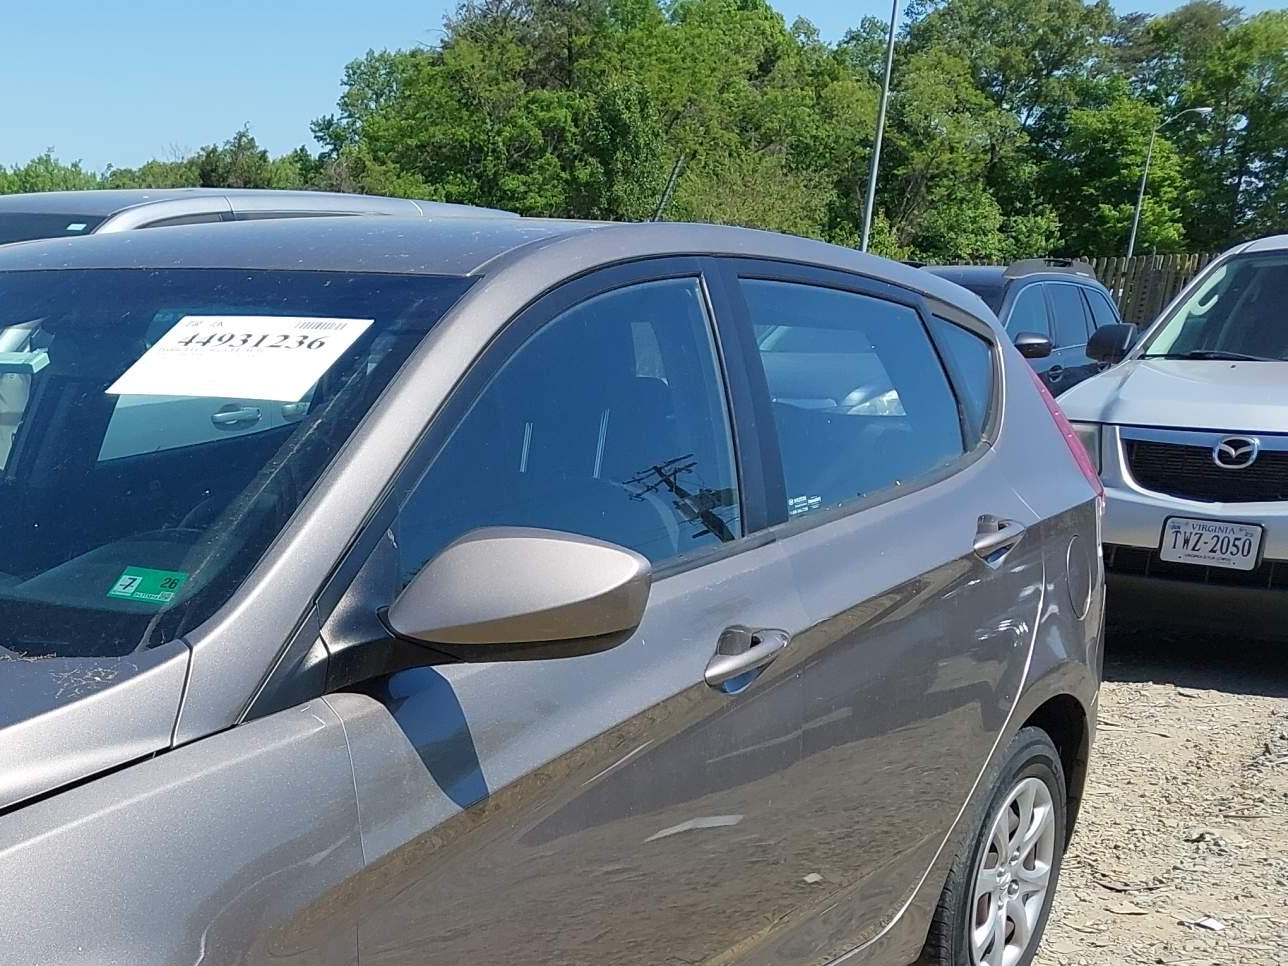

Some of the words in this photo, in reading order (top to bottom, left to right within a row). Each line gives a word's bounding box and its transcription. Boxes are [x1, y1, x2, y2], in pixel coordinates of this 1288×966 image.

[178, 332, 330, 350] 44931236
[1192, 523, 1236, 535] VIRGINIA
[1171, 530, 1252, 557] TWZ-2050
[121, 577, 138, 590] 7
[159, 576, 180, 590] 26
